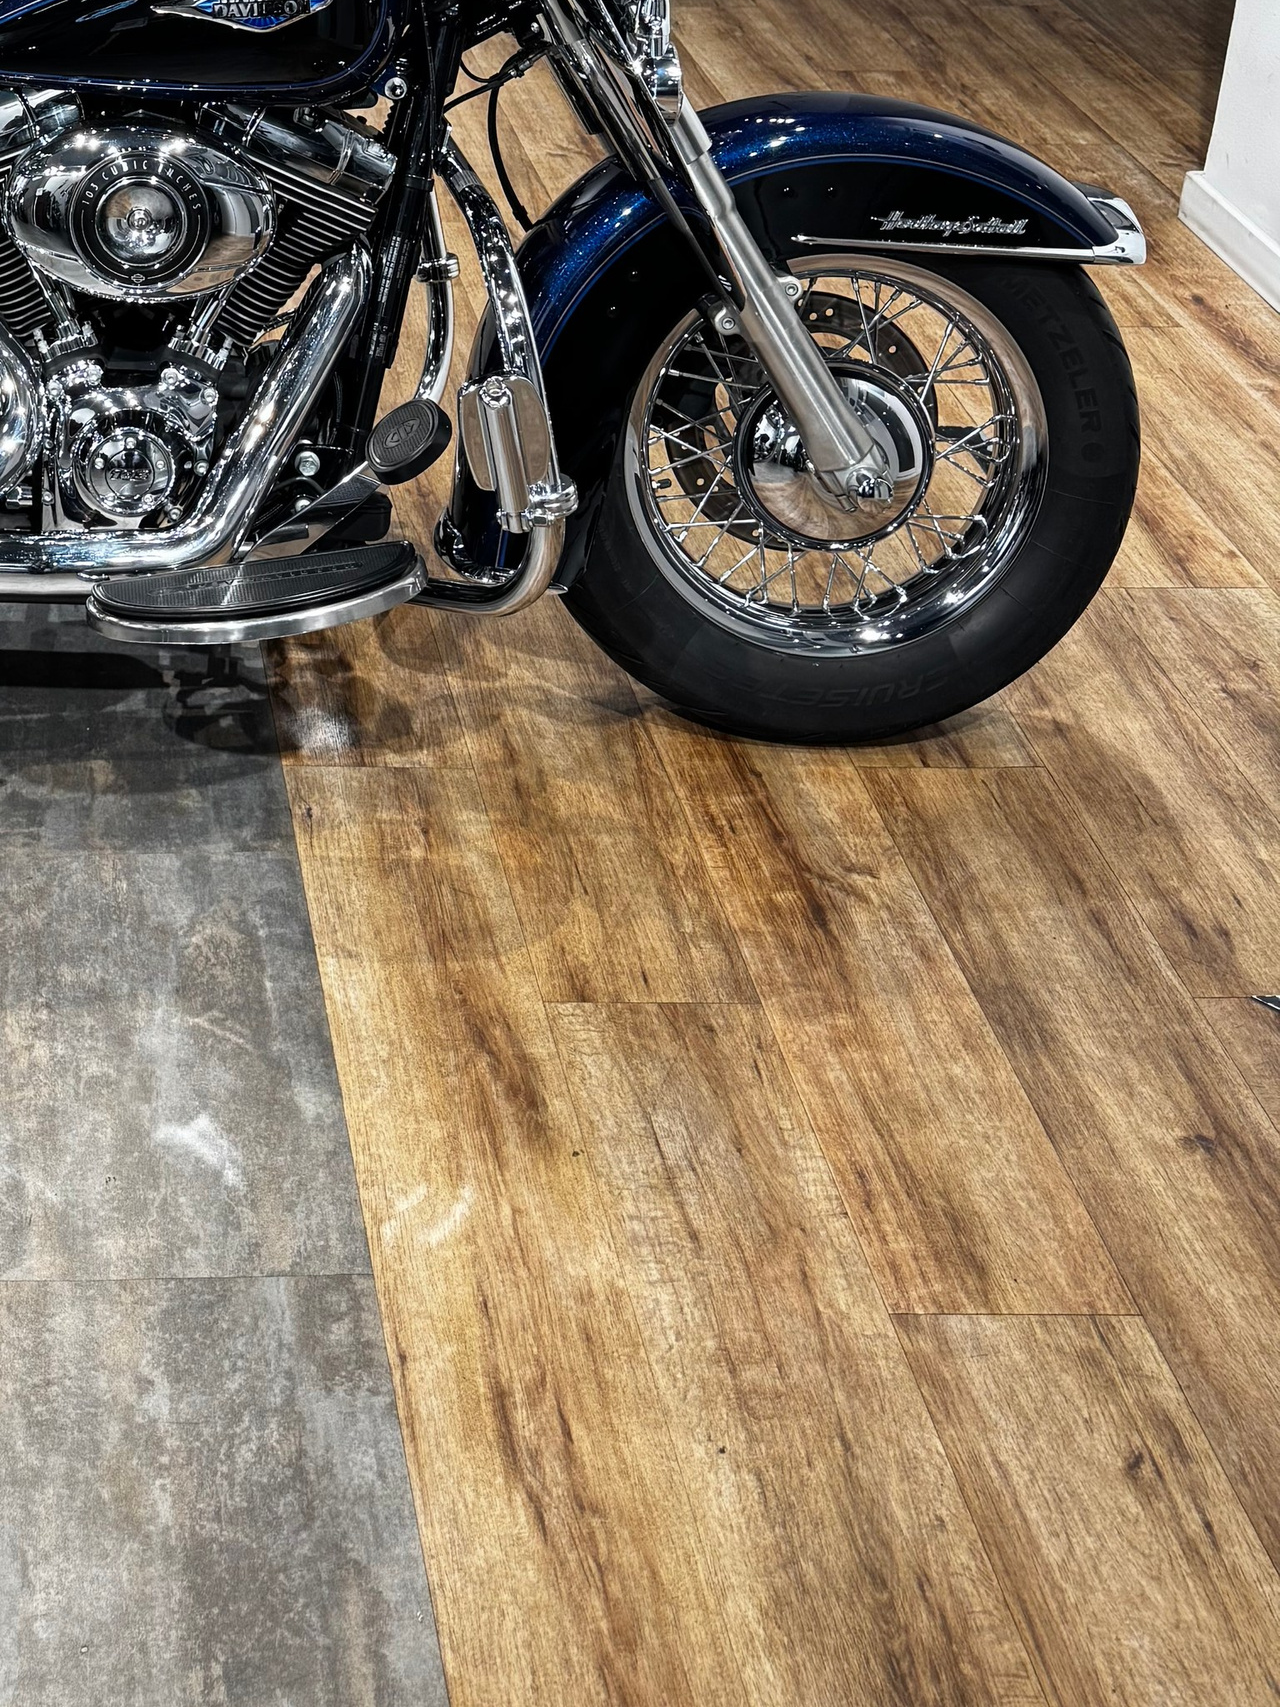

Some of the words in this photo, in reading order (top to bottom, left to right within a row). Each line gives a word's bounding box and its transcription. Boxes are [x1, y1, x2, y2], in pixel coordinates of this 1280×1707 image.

[81, 182, 99, 205] 103
[101, 160, 148, 181] CUBIC
[158, 161, 203, 210] INCHES
